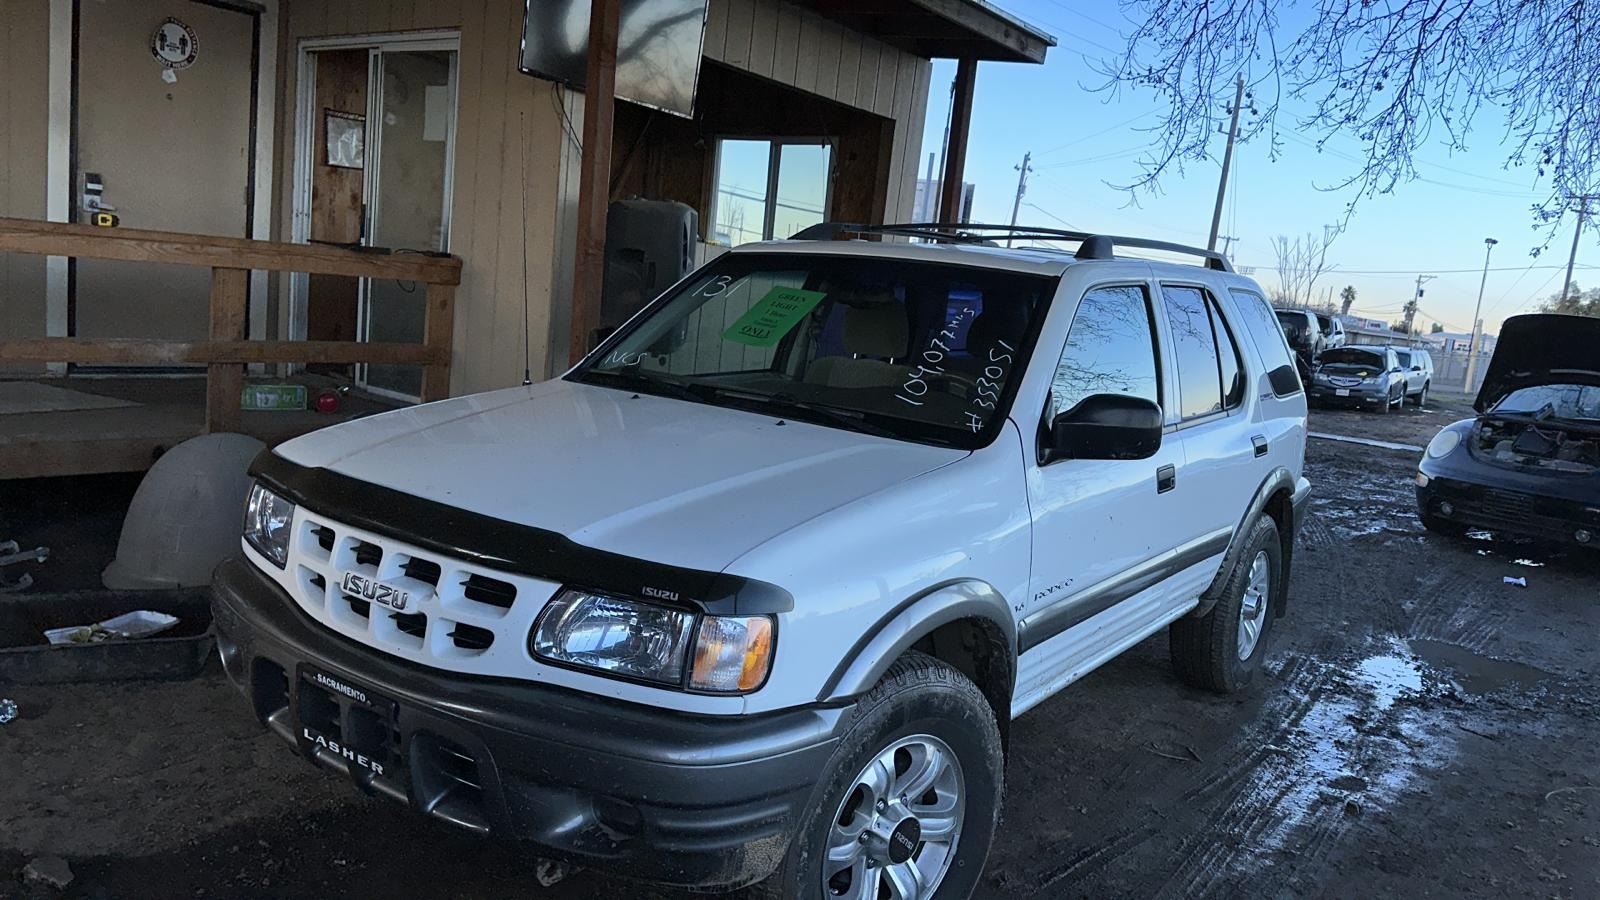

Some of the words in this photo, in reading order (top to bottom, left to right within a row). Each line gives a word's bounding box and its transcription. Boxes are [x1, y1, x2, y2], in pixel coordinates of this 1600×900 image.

[740, 325, 771, 338] ONLY
[342, 572, 408, 610] ISUZU
[641, 586, 680, 601] ISUZU
[317, 673, 367, 703] SACRAMENTO
[303, 727, 384, 776] LASHER
[894, 831, 915, 851] ISUZU
